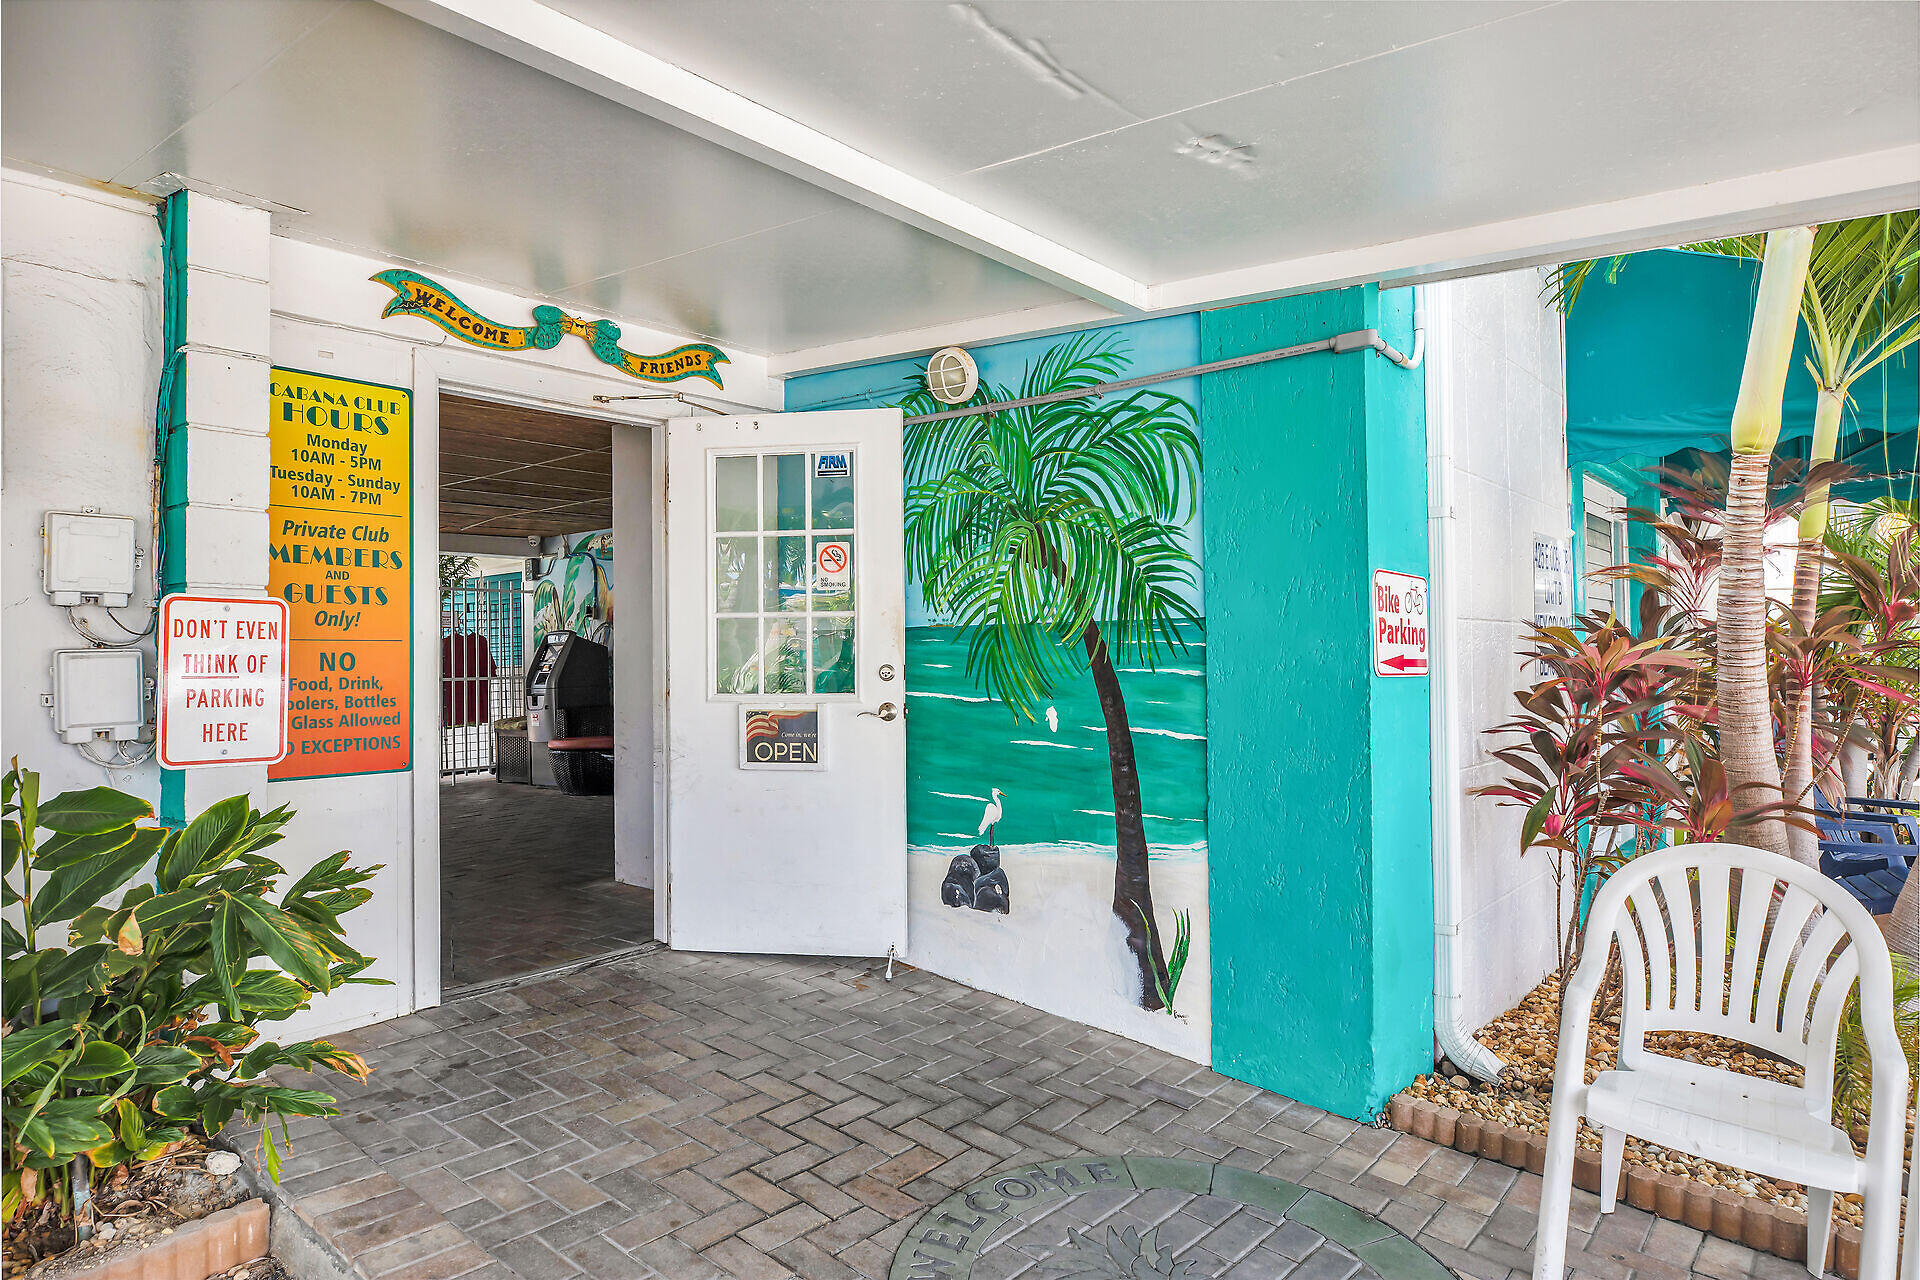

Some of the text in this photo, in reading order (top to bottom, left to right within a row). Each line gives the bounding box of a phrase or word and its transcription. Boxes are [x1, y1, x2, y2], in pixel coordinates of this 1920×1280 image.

[415, 288, 702, 376] WELCOME FRIENDS
[270, 382, 401, 416] CABANA CLUB
[283, 401, 390, 436] HOURS
[306, 433, 368, 456] Monday
[291, 449, 335, 466] 10AM
[350, 456, 382, 471] 5PM
[817, 454, 848, 469] FIRM
[270, 465, 333, 487] Tuesday
[347, 474, 401, 494] Sunday
[291, 485, 335, 501] 10AM
[350, 490, 382, 505] 7PM
[282, 519, 390, 543] Private Club
[269, 542, 403, 570] MEMBERS
[325, 570, 350, 580] AND
[283, 582, 389, 606] GUESTS
[1377, 585, 1400, 614] Bike
[173, 618, 278, 640] DON'T EVEN
[314, 610, 361, 631] Only!
[1378, 617, 1426, 652] Parking
[183, 653, 269, 674] THINK OF
[319, 652, 356, 671] NO
[289, 675, 384, 692] Food, Drink,
[186, 688, 265, 709] PARKING
[288, 695, 397, 712] oolers, Bottles
[291, 711, 401, 730] Glass Allowed
[202, 722, 249, 743] HERE
[301, 735, 401, 755] EXCEPTIONS
[754, 741, 817, 762] OPEN
[906, 1163, 1120, 1280] WELCOME
